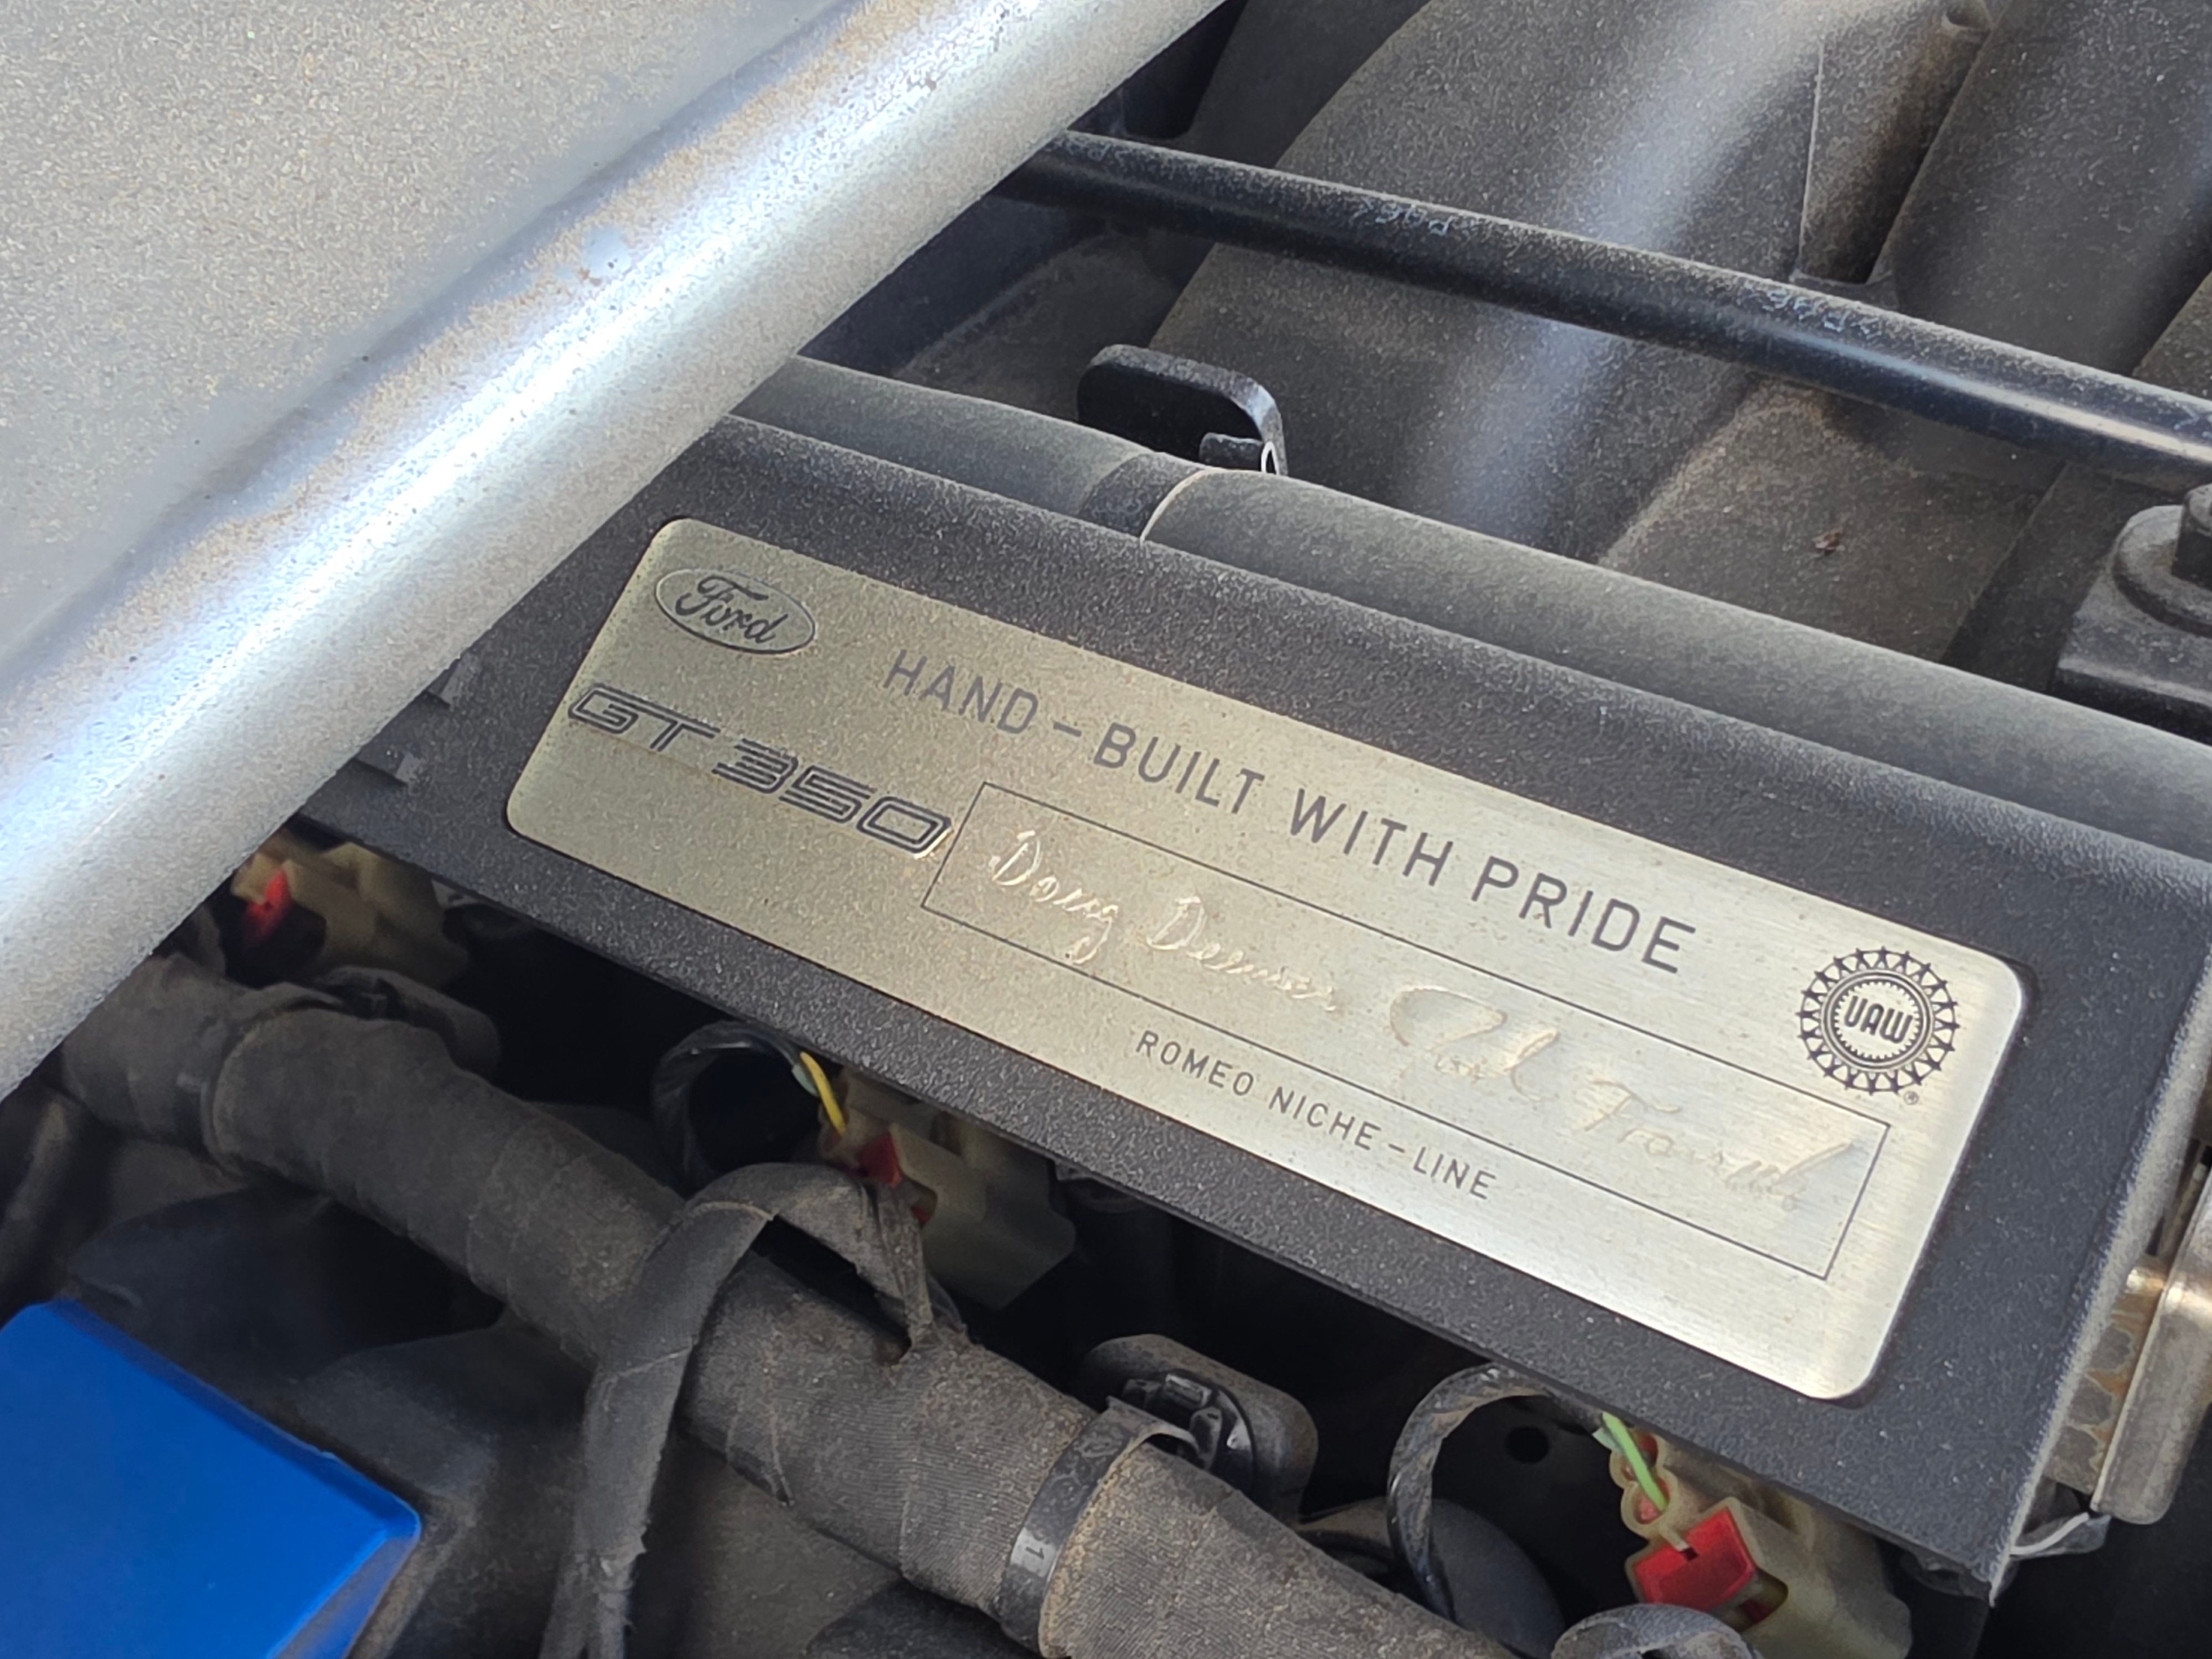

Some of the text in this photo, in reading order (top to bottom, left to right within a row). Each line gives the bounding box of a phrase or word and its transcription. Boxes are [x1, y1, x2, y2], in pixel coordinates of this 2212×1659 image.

[675, 574, 789, 644] Ford
[1290, 787, 1454, 886] WITH
[1470, 855, 1696, 974] PRIDE
[1843, 995, 1913, 1044] UAW
[1135, 1029, 1255, 1097] ROMEO
